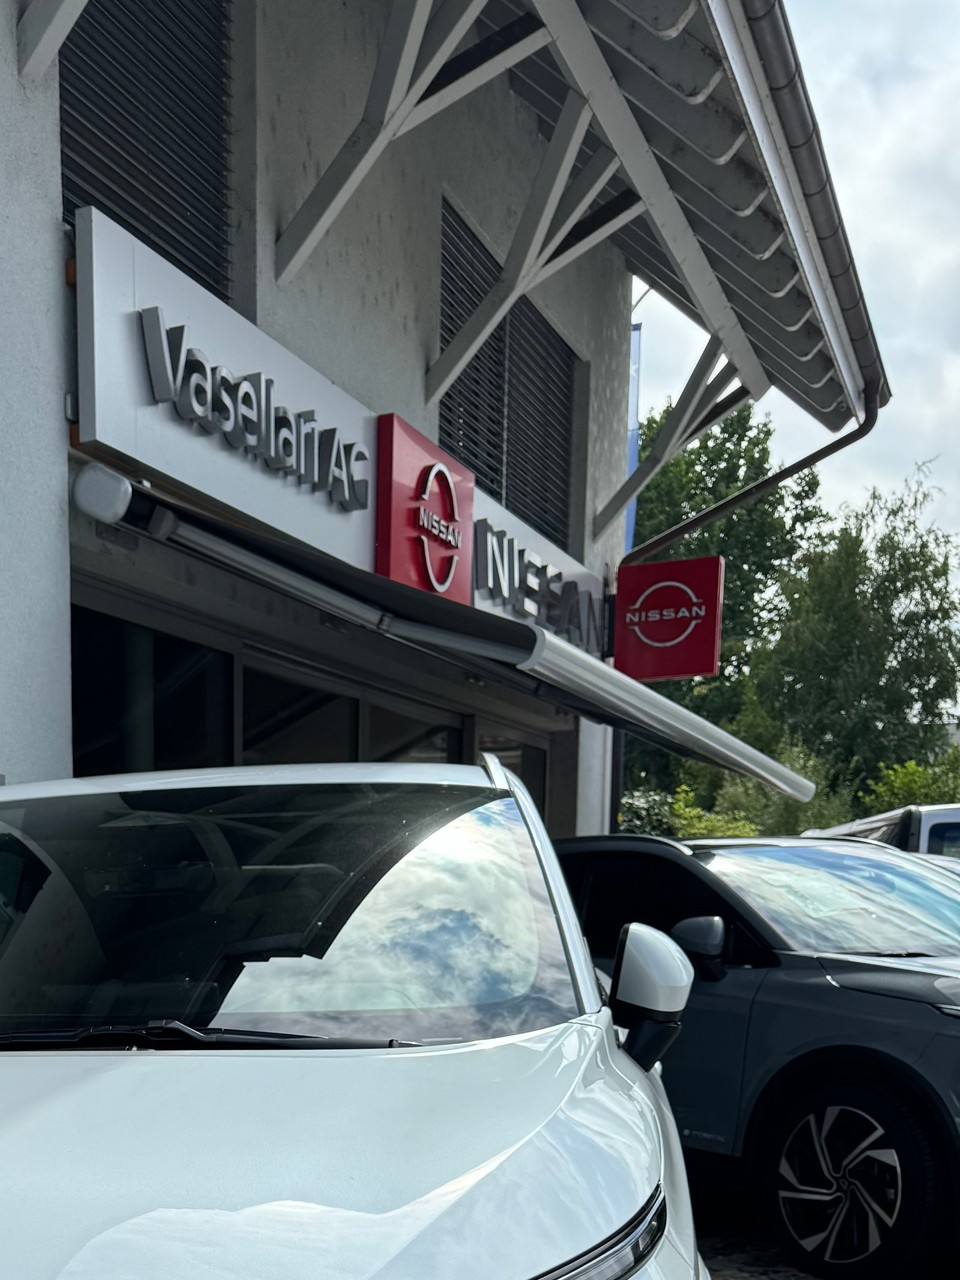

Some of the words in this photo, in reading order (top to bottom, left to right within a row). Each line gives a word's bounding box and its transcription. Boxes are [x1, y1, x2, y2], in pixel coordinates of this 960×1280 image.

[141, 306, 320, 492] Vasellari
[321, 427, 370, 512] AG
[419, 505, 463, 550] NISSAN
[625, 604, 707, 624] NISSAN
